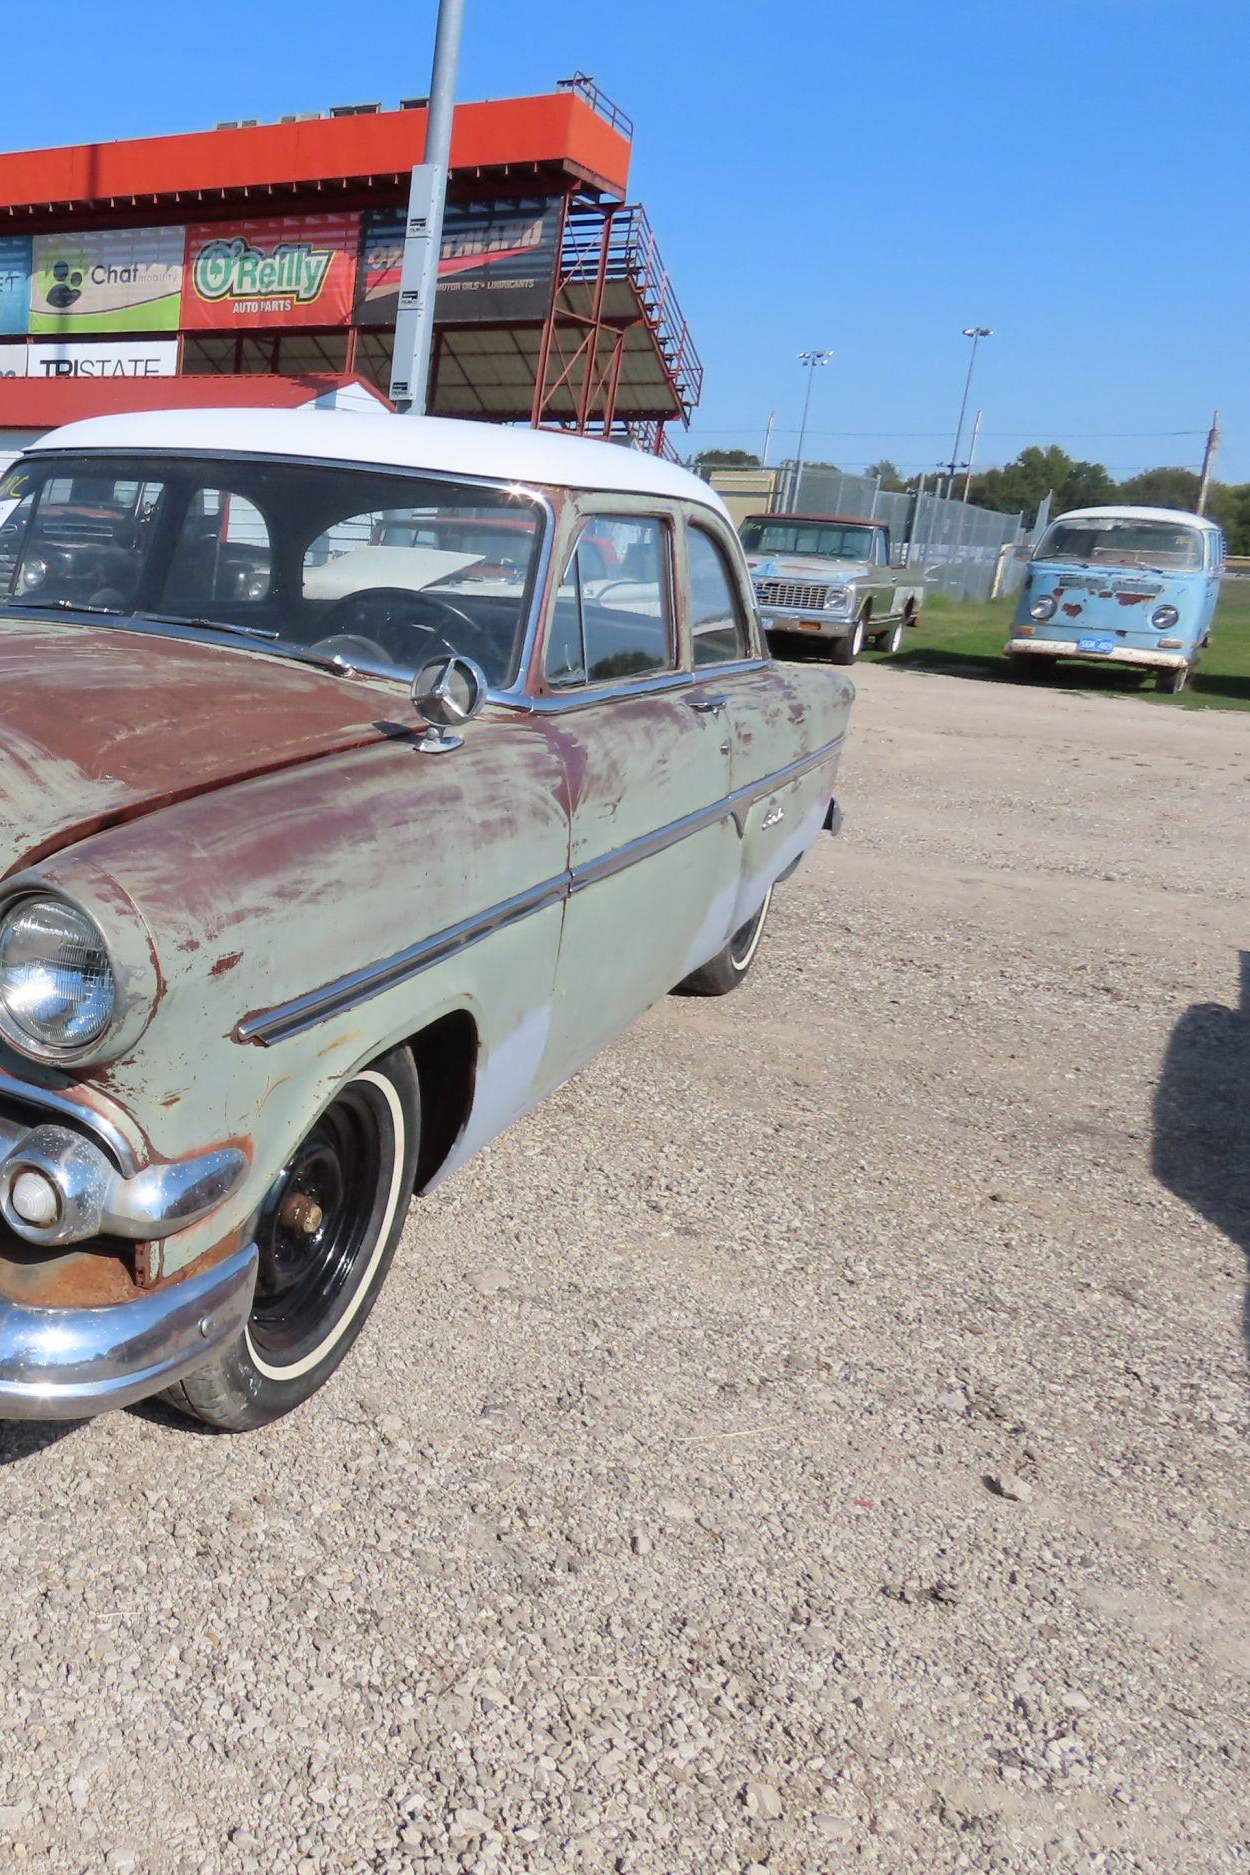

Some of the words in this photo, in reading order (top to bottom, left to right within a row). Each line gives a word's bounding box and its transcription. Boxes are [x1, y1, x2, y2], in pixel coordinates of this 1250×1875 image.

[91, 264, 139, 285] Chat
[139, 272, 178, 283] mobility
[197, 238, 330, 297] O'Reilly
[487, 279, 535, 289] LUBRICANTS
[232, 302, 258, 313] AUTO
[260, 300, 291, 312] PARTS
[39, 358, 161, 377] TRISTATE
